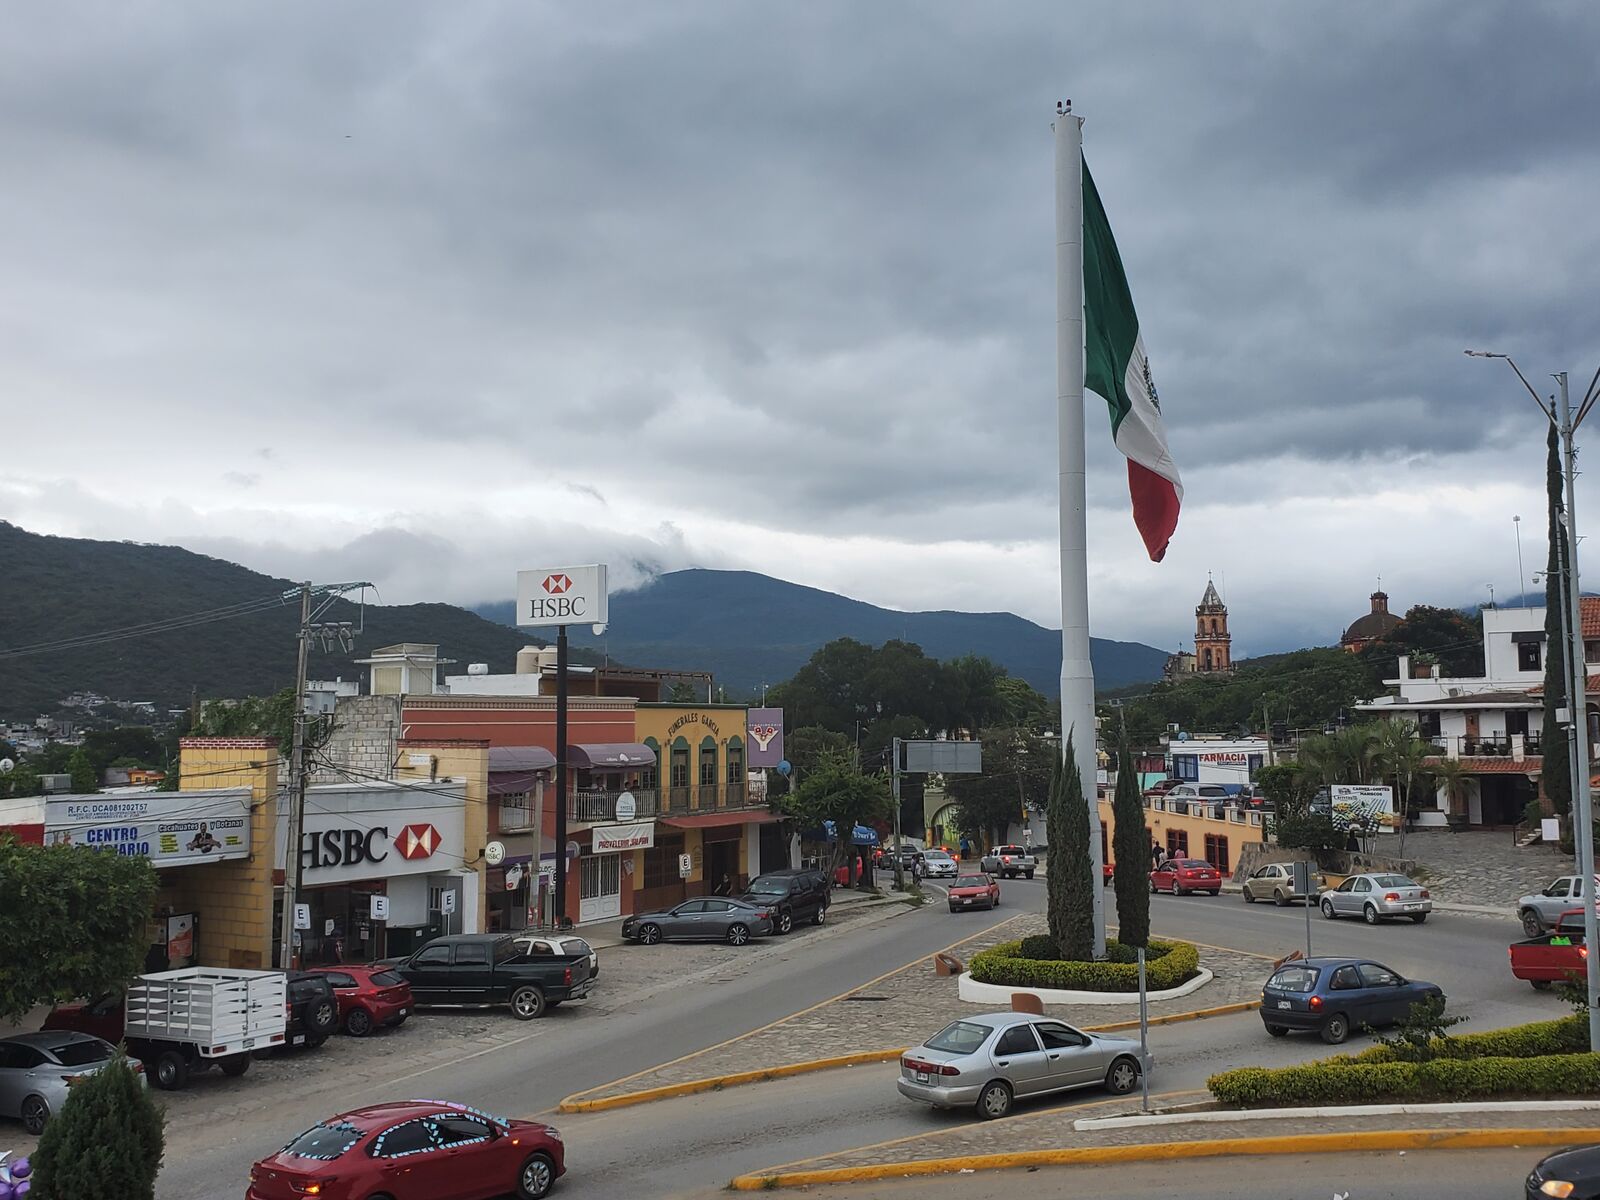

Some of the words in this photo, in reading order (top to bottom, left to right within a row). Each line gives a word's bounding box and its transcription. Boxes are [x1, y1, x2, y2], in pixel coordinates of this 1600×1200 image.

[529, 596, 586, 618] HSBC
[668, 712, 698, 737] FUNERALES
[1199, 753, 1247, 762] FARMACIA
[68, 805, 91, 813] R.F.C.
[158, 822, 199, 832] Cacahuates
[216, 820, 243, 829] Botanas
[87, 826, 138, 843] CENTRO
[302, 826, 389, 870] HSBC
[376, 900, 383, 911] E
[447, 895, 452, 905] E
[297, 908, 305, 920] E
